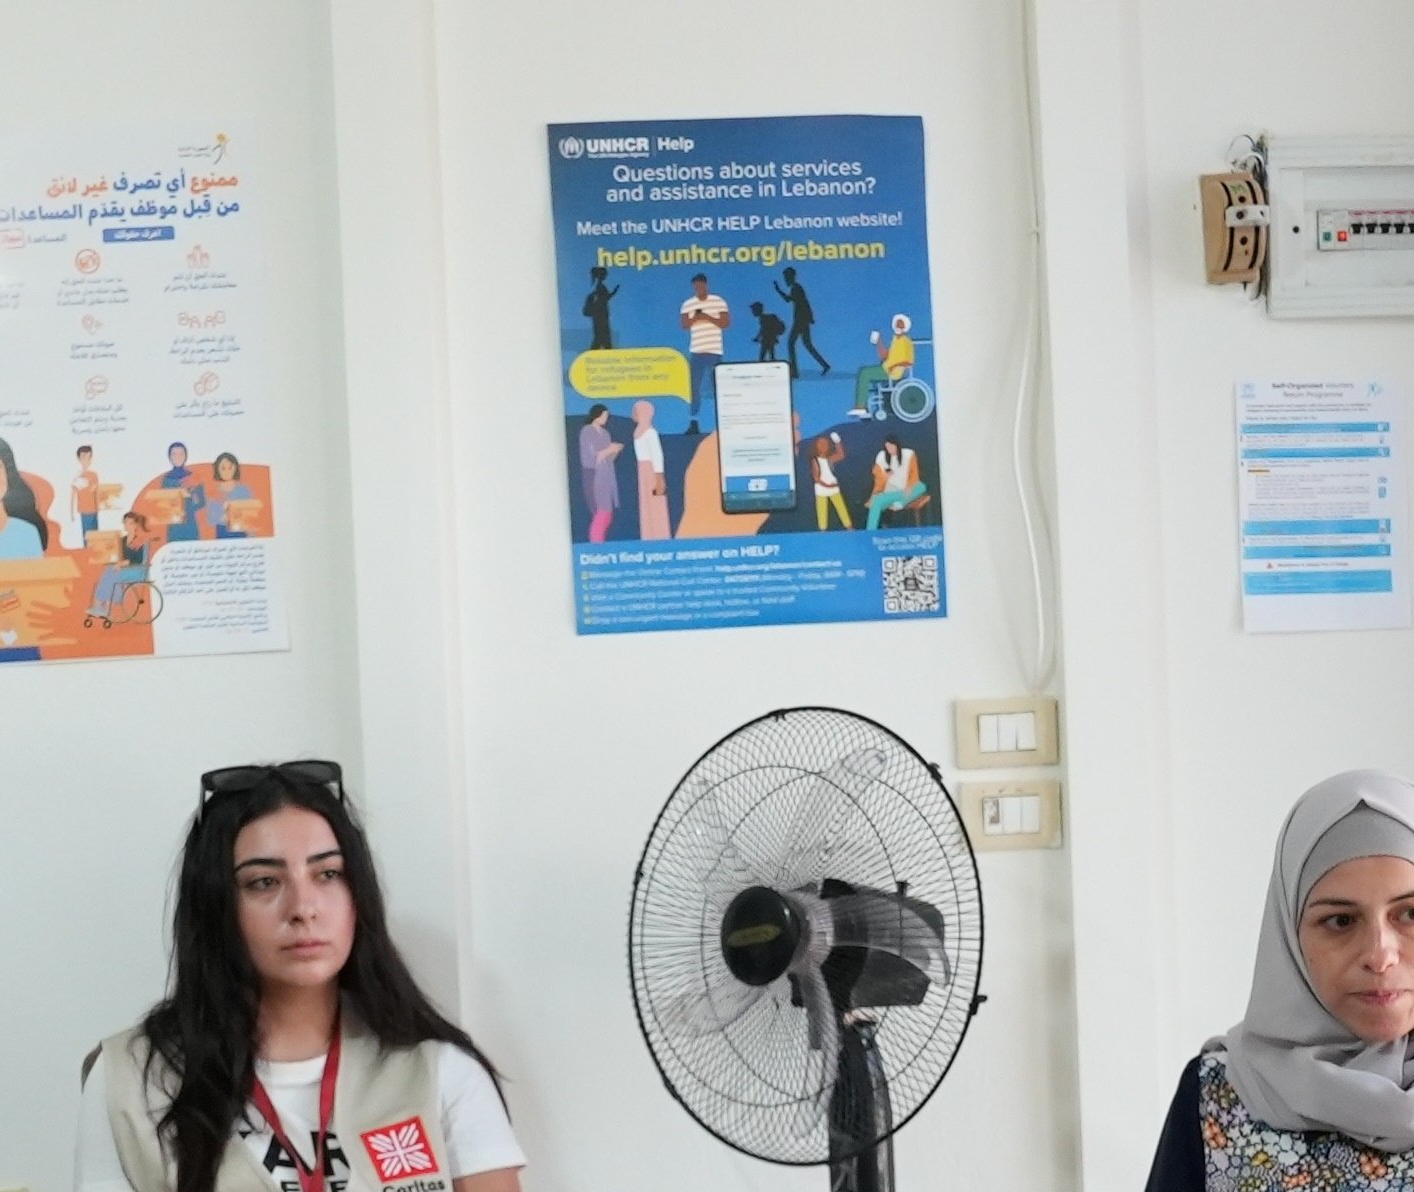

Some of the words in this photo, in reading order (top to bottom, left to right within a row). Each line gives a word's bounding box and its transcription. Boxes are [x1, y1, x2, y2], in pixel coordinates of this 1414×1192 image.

[586, 137, 650, 153] UNHCR
[657, 137, 695, 153] Help
[113, 171, 161, 194] تصرف
[613, 163, 714, 183] Questions
[719, 161, 777, 179] about
[782, 159, 862, 177] services
[47, 175, 77, 198] لائق
[82, 178, 107, 198] غير
[166, 168, 185, 198] أي
[190, 173, 238, 194] ممنوع
[606, 184, 644, 202] and
[649, 182, 753, 201] assistance
[758, 181, 776, 197] in
[782, 176, 876, 197] Lebanon?
[130, 200, 177, 220] موظف
[217, 201, 240, 217] من
[576, 221, 618, 235] Meet
[621, 220, 647, 234] the
[651, 217, 713, 233] UNHCR
[718, 215, 761, 231] HELP
[764, 213, 833, 230] Lebanon
[836, 211, 903, 228] website!
[597, 241, 885, 271] help.unhcr.org/lebanon
[619, 551, 644, 563] find
[645, 551, 675, 565] your
[676, 550, 720, 561] answer
[722, 549, 739, 558] on
[740, 544, 780, 558] HELP?
